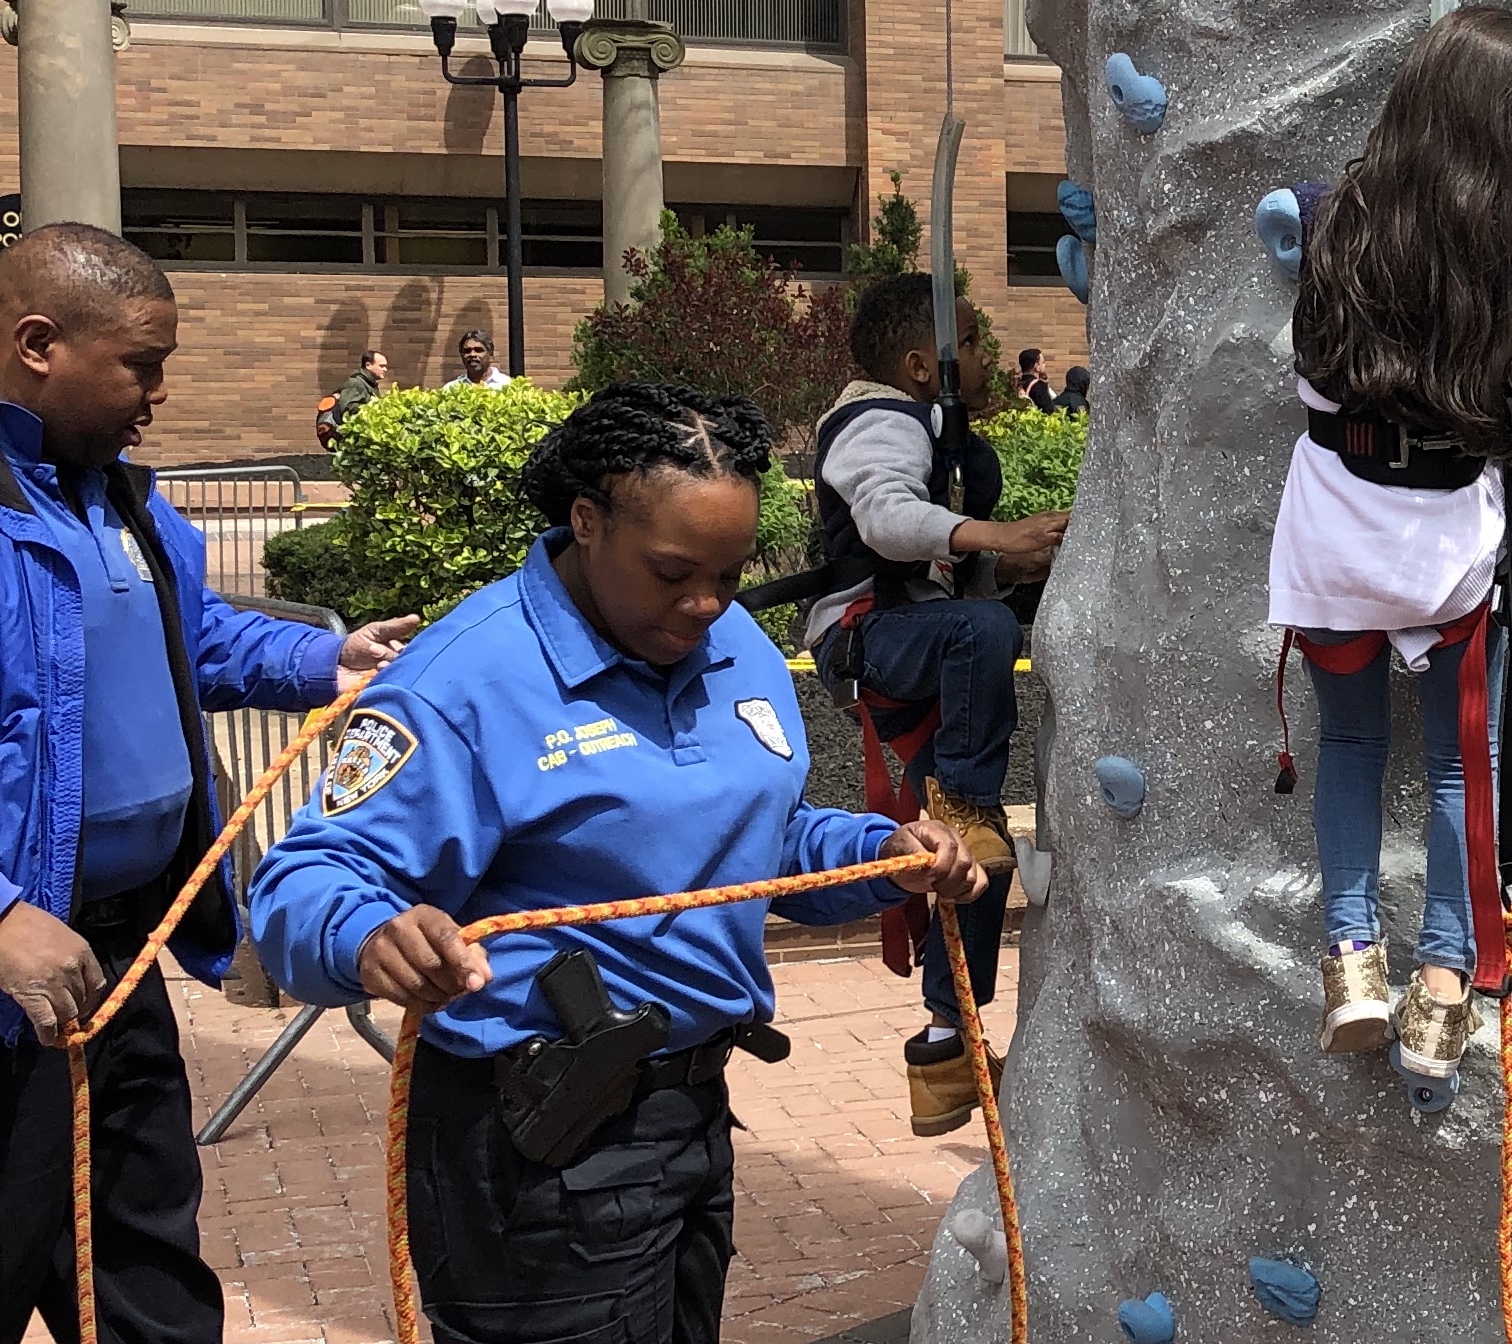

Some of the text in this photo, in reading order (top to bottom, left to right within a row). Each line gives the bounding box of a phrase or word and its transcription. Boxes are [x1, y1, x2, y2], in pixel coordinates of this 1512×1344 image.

[360, 718, 396, 743] POLICE
[545, 729, 573, 749] P.O.
[537, 749, 568, 771] CAB
[578, 733, 638, 756] OUTREACH
